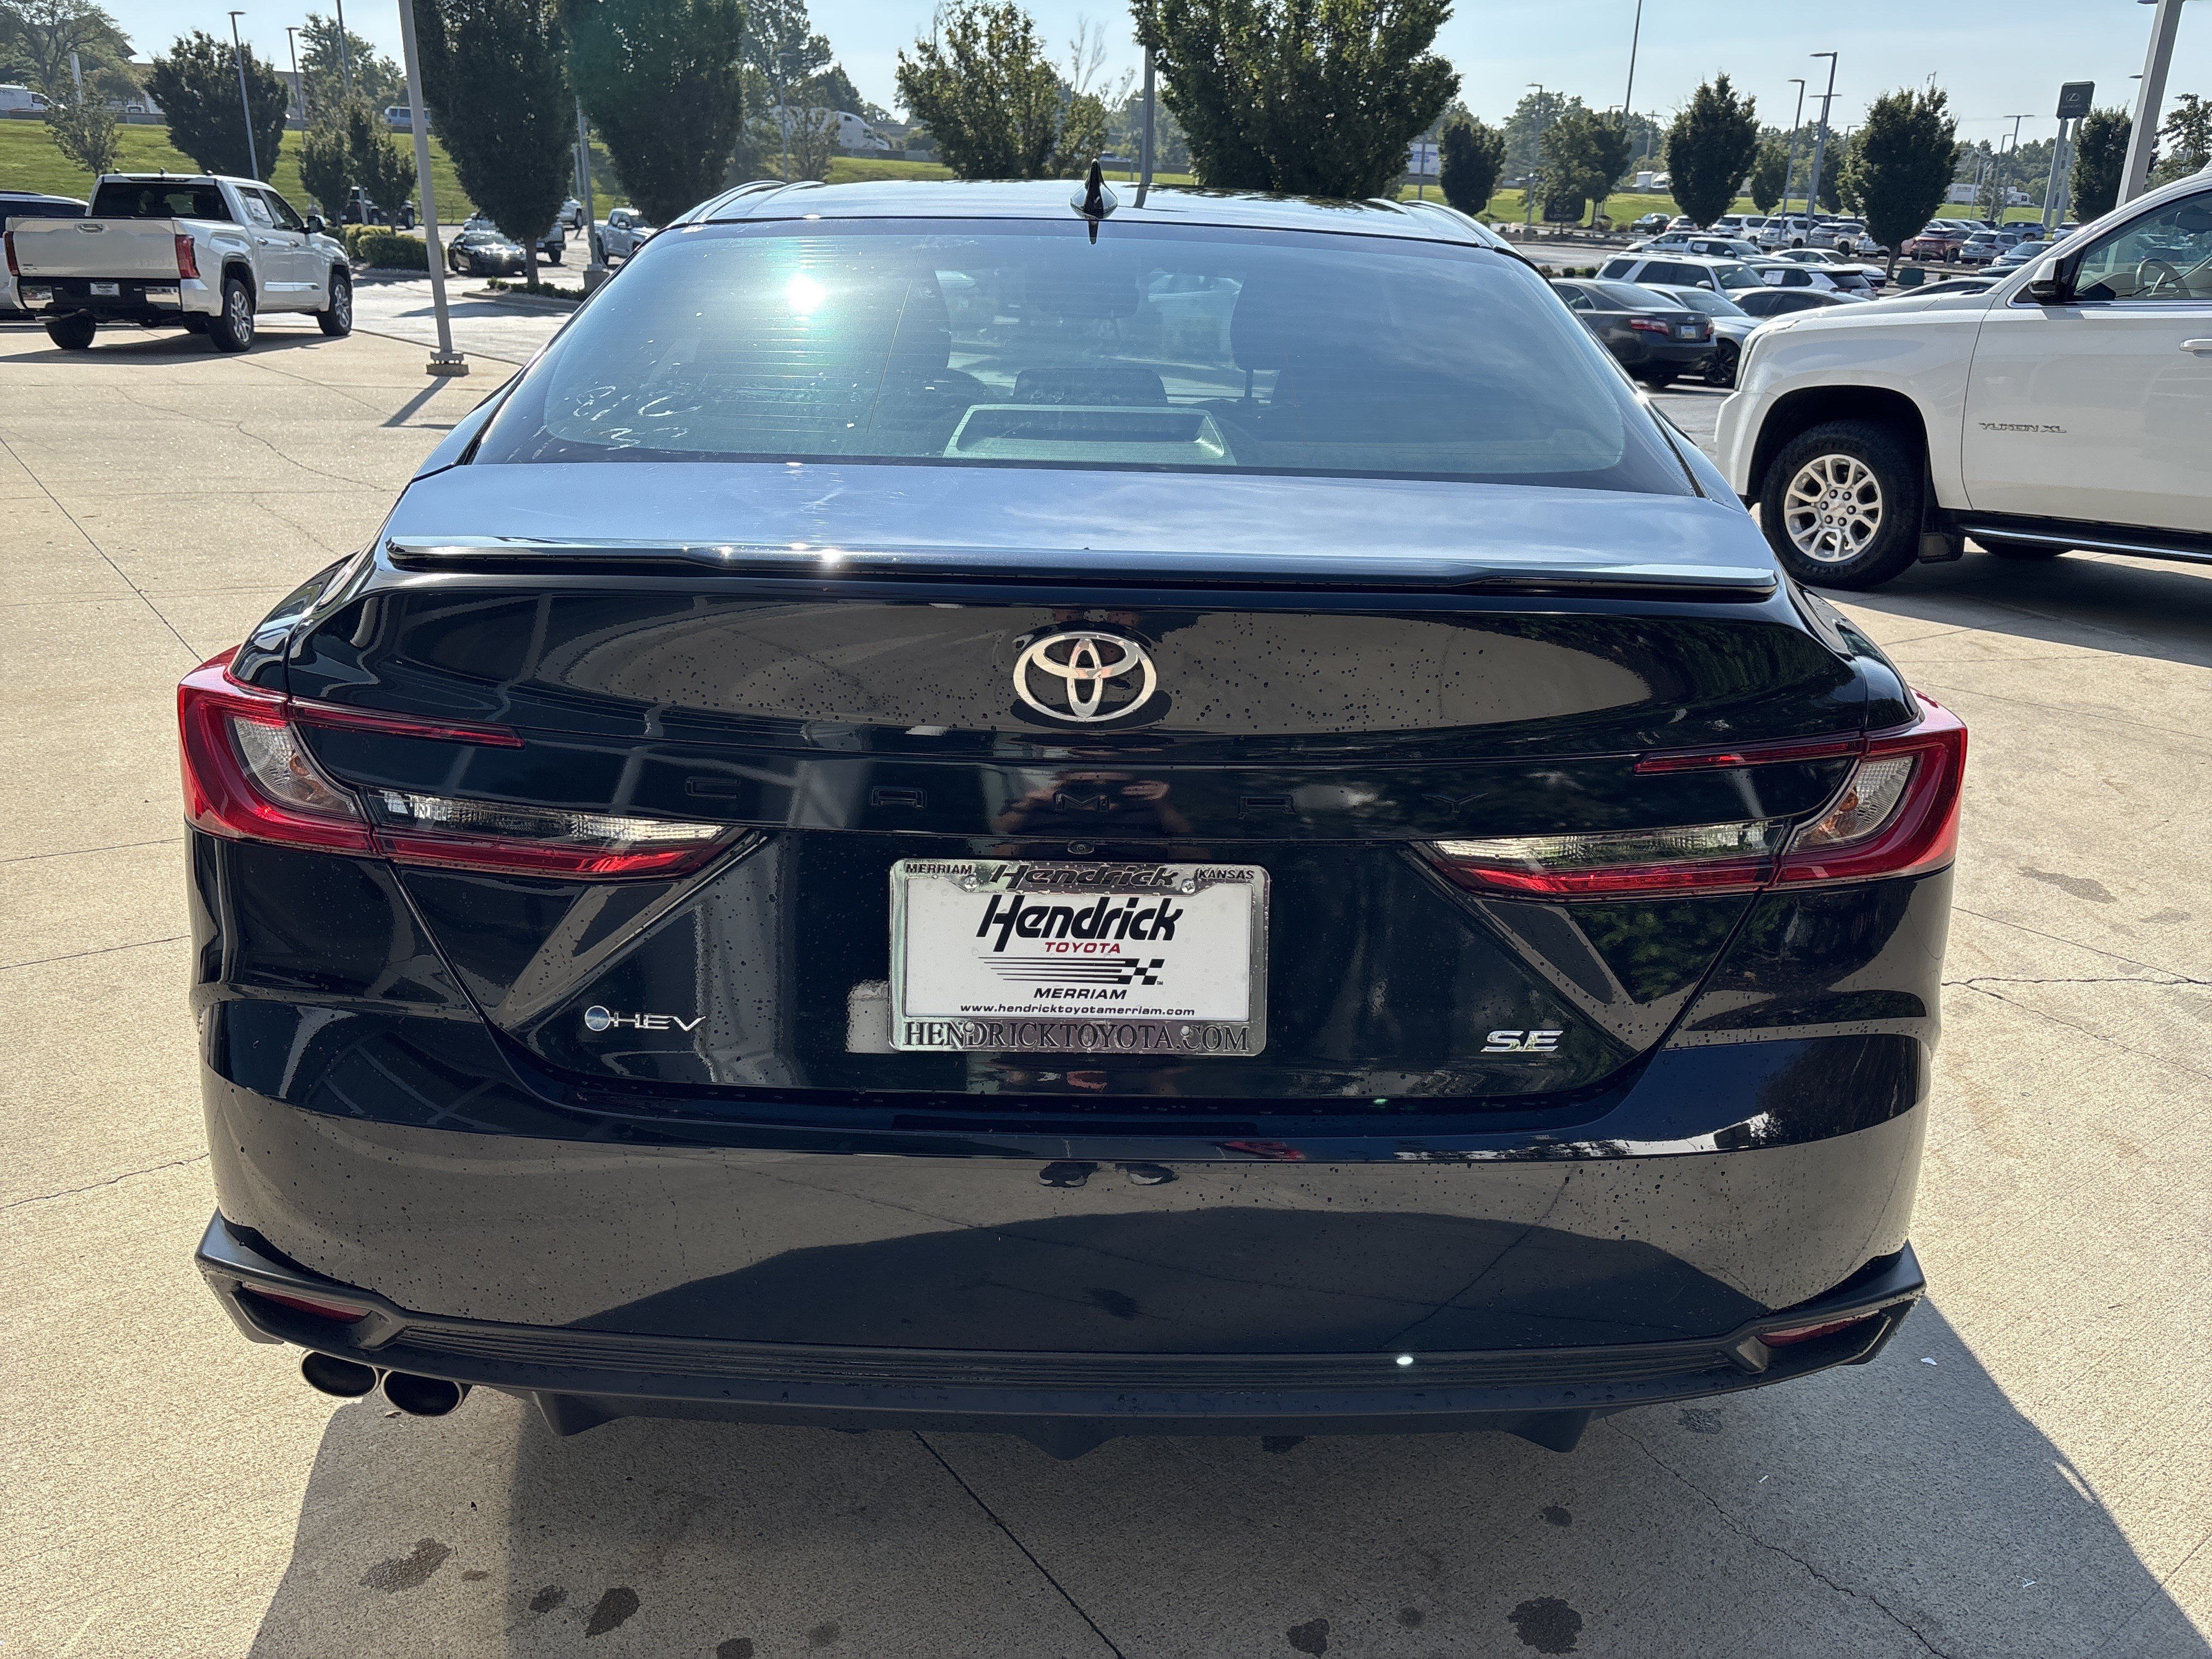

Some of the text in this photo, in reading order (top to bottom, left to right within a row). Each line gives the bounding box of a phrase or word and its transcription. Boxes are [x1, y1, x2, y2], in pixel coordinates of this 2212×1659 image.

[685, 775, 1489, 820] CAMRY
[905, 863, 973, 875] MERRIAM
[989, 863, 1179, 890] Hendrick
[1197, 868, 1255, 880] KANSAS
[976, 894, 1184, 952] Hendrick
[1045, 941, 1121, 954] TOYOTA
[1033, 988, 1127, 1000] MERRIAM
[960, 1003, 1195, 1017] www.hendricktoyotamerriam.com
[903, 1021, 1249, 1052] HENDRICKTOYOTA.COM
[1480, 1030, 1564, 1052] SE
